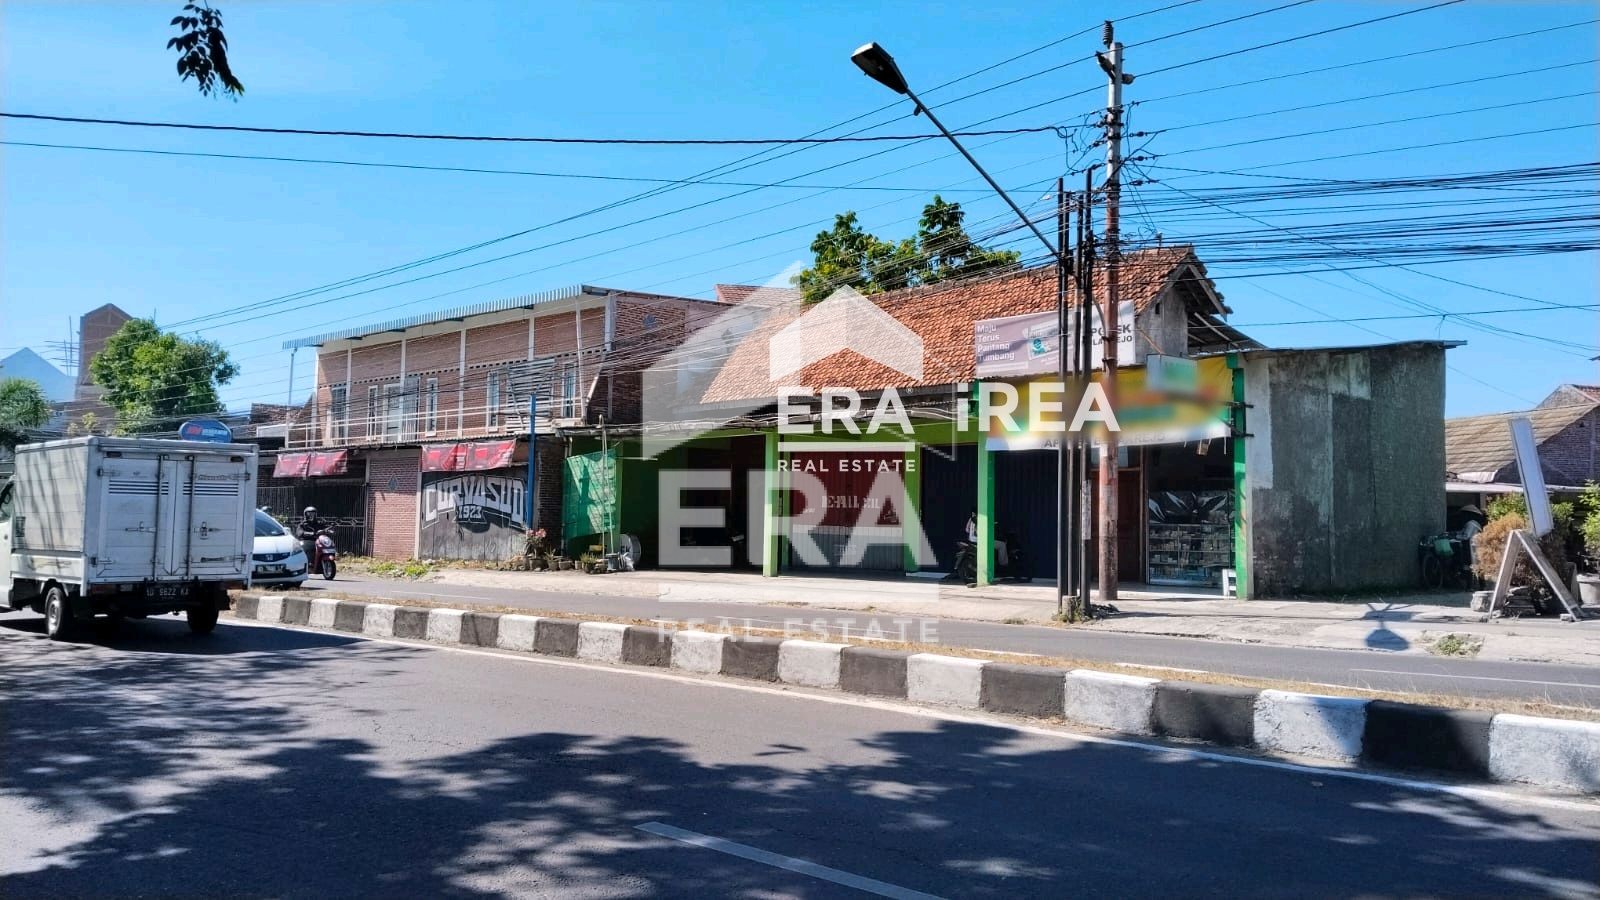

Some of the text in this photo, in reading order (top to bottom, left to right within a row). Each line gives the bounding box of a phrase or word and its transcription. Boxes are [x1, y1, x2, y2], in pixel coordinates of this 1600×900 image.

[977, 324, 997, 333] Maju
[977, 334, 1000, 343] Terus
[977, 343, 1010, 352] Pantang
[977, 352, 1015, 361] Tumbang
[459, 505, 482, 519] 1923
